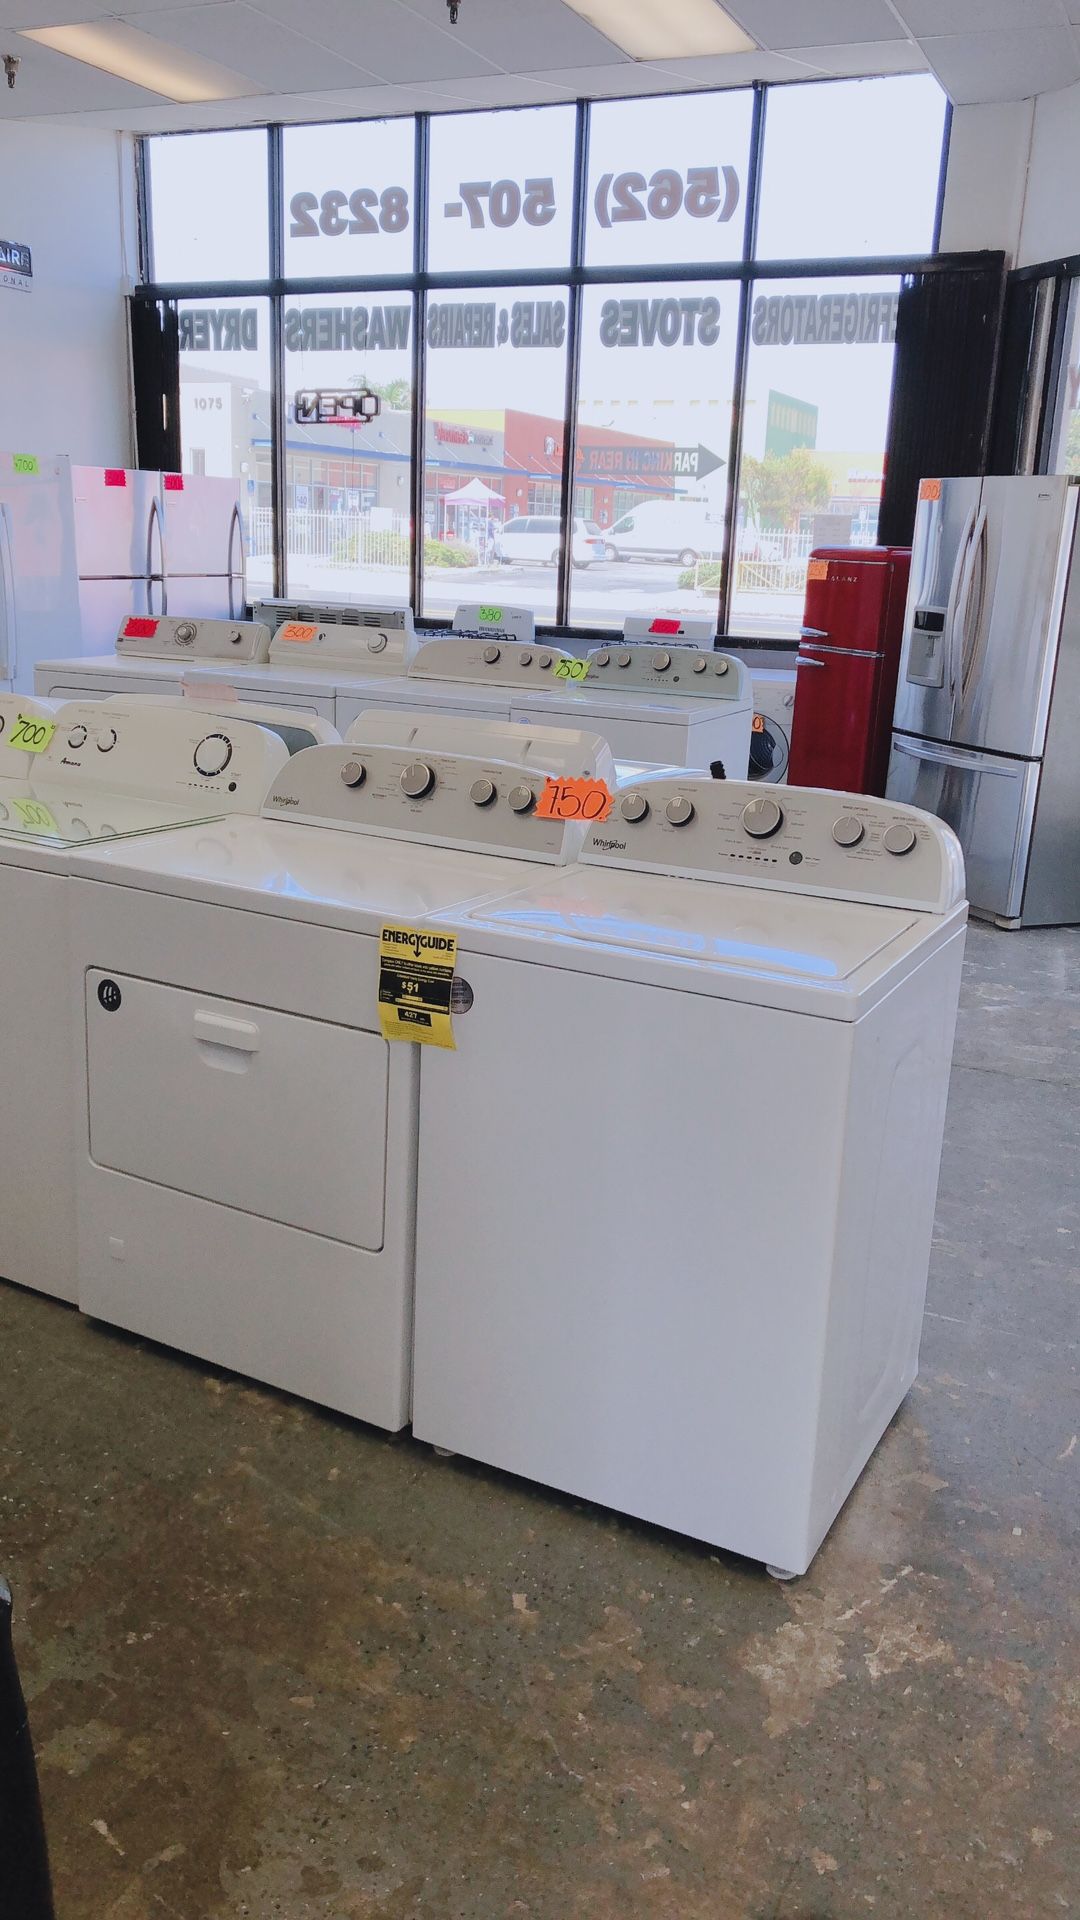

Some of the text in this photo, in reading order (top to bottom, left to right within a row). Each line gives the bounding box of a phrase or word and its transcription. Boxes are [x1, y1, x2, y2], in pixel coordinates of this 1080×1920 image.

[194, 397, 223, 411] 1075
[60, 757, 82, 767] Amana
[272, 794, 300, 806] Whirlpool
[592, 837, 627, 850] Whirlpool
[382, 928, 455, 952] ENERGYGUIDE
[401, 981, 419, 993] $51
